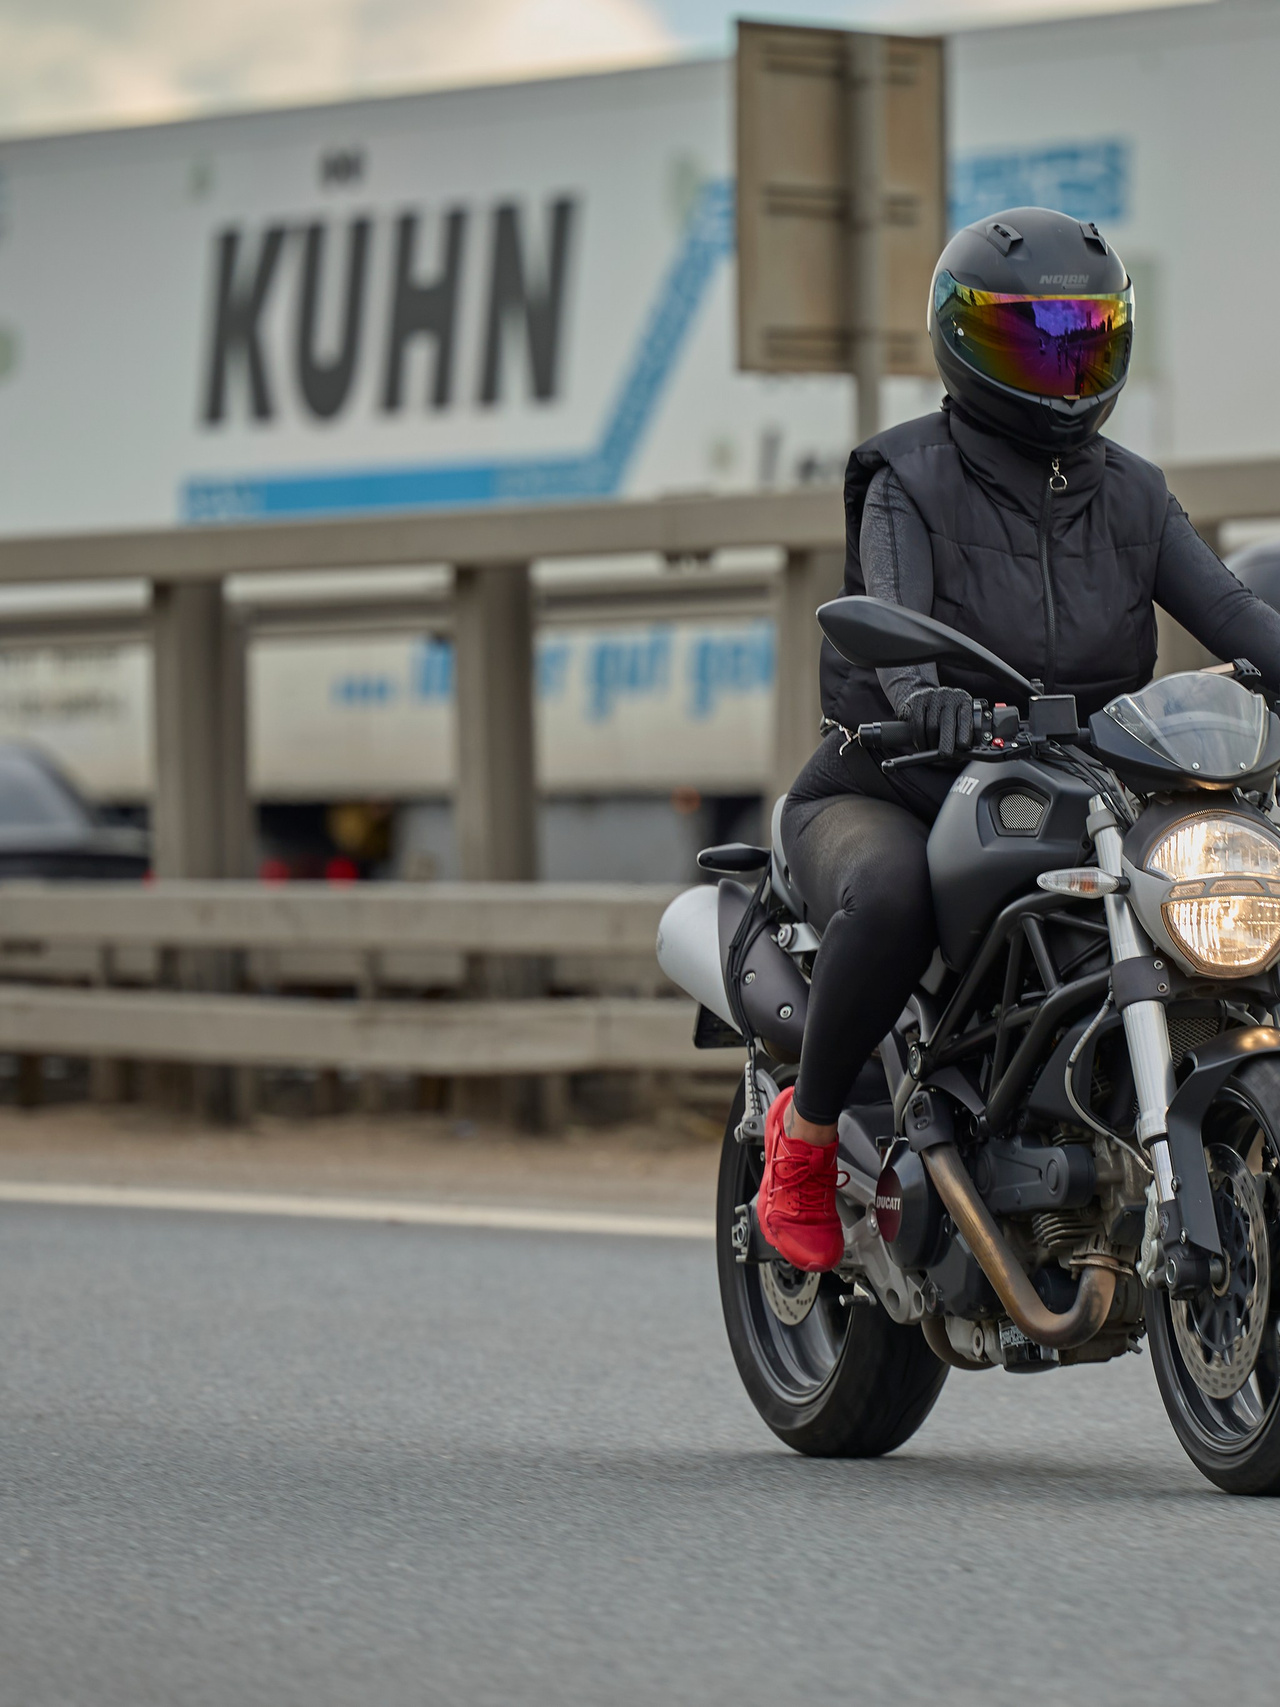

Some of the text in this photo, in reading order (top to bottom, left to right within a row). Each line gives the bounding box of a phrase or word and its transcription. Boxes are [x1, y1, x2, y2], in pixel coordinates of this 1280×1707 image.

[202, 148, 580, 429] KÜHN
[1039, 274, 1090, 288] NOLAN
[876, 1195, 901, 1211] DUCATI
